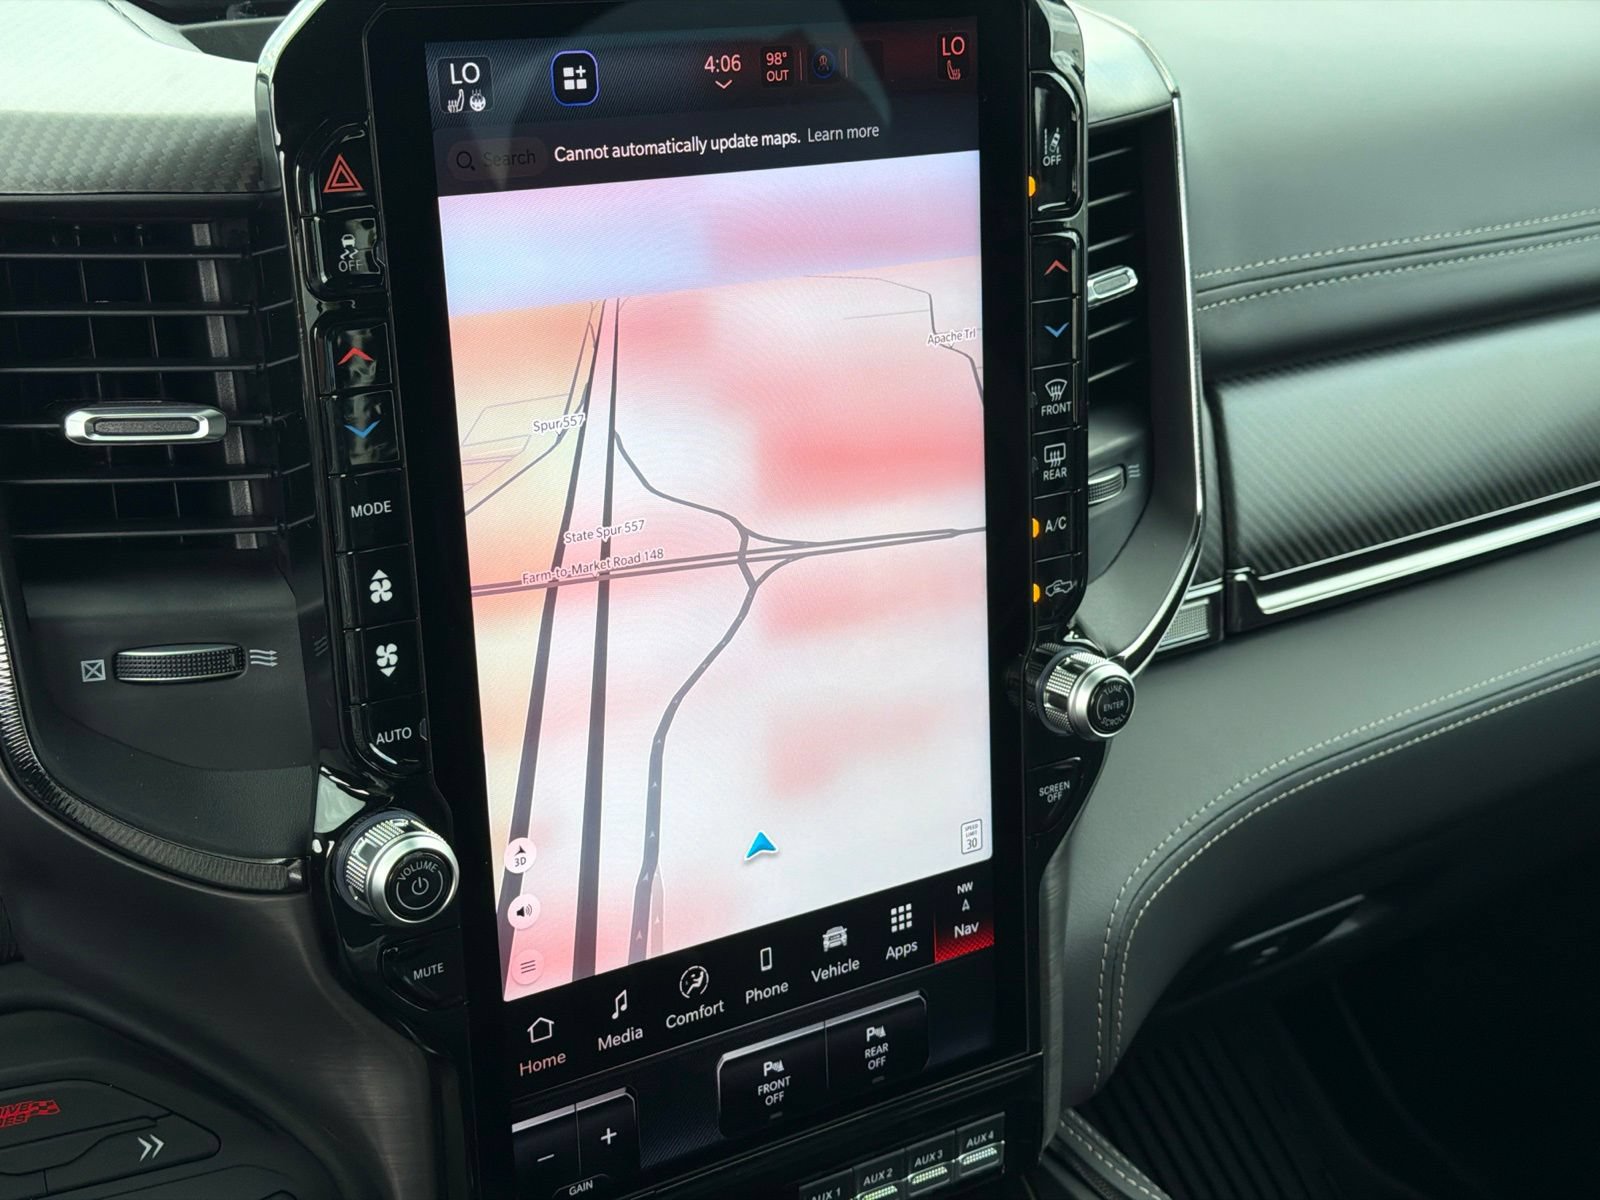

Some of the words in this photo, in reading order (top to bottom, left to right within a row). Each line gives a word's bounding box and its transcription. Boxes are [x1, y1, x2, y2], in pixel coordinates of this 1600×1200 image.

[941, 35, 966, 56] LO
[704, 54, 742, 73] 4:06
[766, 51, 788, 66] 98°
[449, 61, 481, 85] LO
[766, 70, 789, 82] OUT
[554, 144, 609, 163] Cannot
[611, 135, 707, 155] automatically
[710, 132, 758, 153] update
[761, 132, 801, 148] maps.
[807, 127, 844, 143] Learn
[846, 126, 880, 139] more
[483, 148, 537, 169] Search
[1042, 154, 1062, 167] OFF
[338, 260, 364, 273] OFF
[927, 332, 963, 346] Apache
[1041, 401, 1072, 417] FRONT
[533, 420, 561, 433] Spur
[562, 414, 585, 429] 557
[1043, 467, 1068, 481] REAR
[350, 500, 393, 519] MODE
[563, 531, 594, 545] State
[596, 525, 622, 541] Spur
[624, 519, 645, 534] 557
[1045, 516, 1067, 533] A/C
[522, 561, 611, 585] Farm-to-Market
[613, 556, 641, 570] Road
[644, 548, 664, 562] 148
[1103, 684, 1123, 696] TUNE
[1103, 700, 1125, 712] ENTER
[1101, 713, 1128, 728] SCROLL
[375, 726, 413, 746] AUTO
[1039, 780, 1071, 798] SCREEN
[1047, 792, 1063, 804] OFF
[966, 837, 978, 850] 30
[398, 860, 440, 882] VOLUME
[514, 856, 527, 868] 3D
[957, 881, 974, 895] NW
[953, 921, 980, 939] Nav
[885, 941, 918, 961] Apps
[413, 962, 445, 981] MUTE
[811, 958, 860, 983] Vehicle
[745, 981, 789, 1004] Phone
[665, 1000, 725, 1029] Comfort
[597, 1026, 644, 1052] Media
[864, 1043, 889, 1060] REAR
[519, 1051, 567, 1077] Home
[867, 1057, 887, 1071] OFF
[757, 1075, 792, 1097] FRONT
[765, 1091, 785, 1107] OFF
[966, 1134, 988, 1149] AUX
[988, 1130, 995, 1140] 4
[914, 1154, 936, 1168] AUX
[937, 1149, 944, 1159] 3
[863, 1172, 886, 1186] AUX
[886, 1168, 893, 1179] 2
[569, 1180, 593, 1196] GAIN
[836, 1187, 841, 1197] 1
